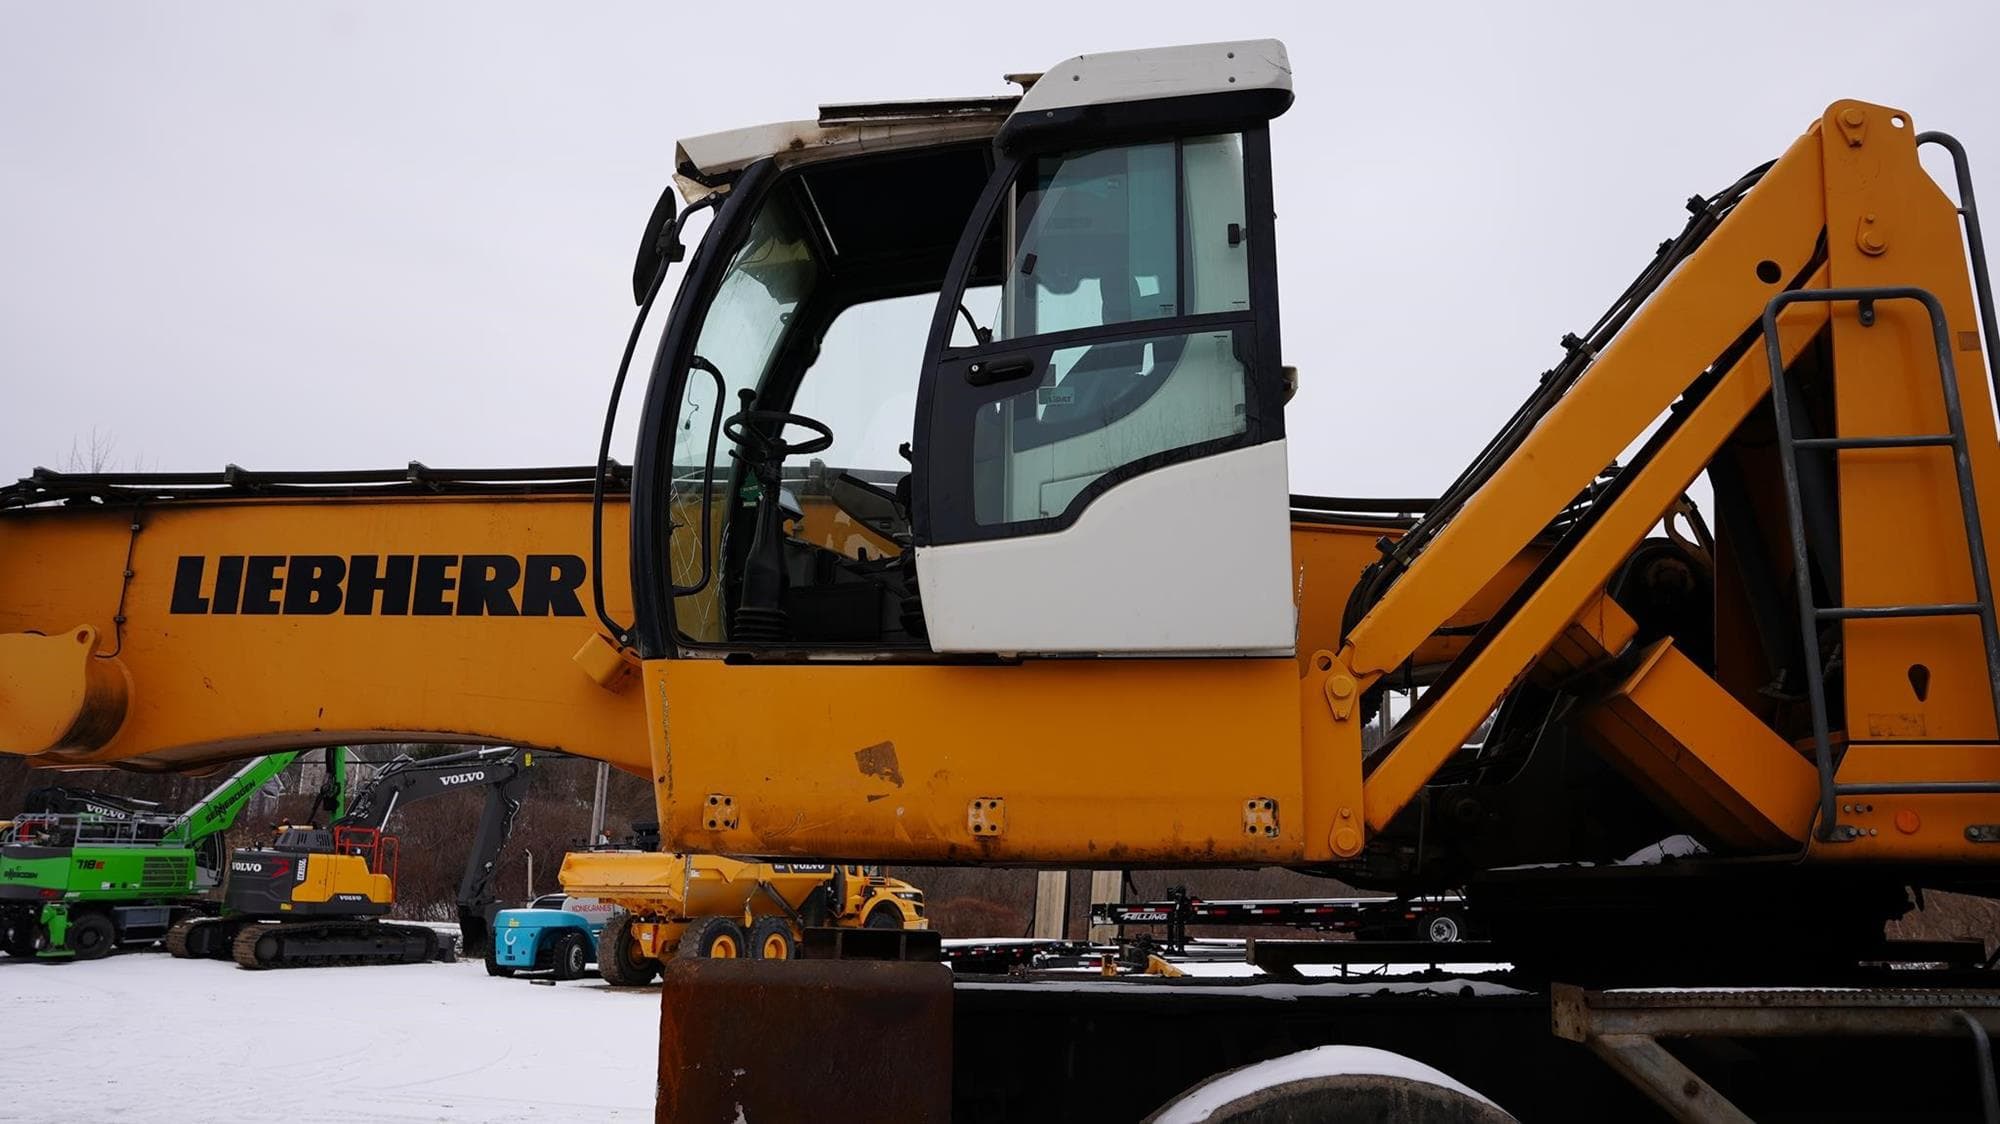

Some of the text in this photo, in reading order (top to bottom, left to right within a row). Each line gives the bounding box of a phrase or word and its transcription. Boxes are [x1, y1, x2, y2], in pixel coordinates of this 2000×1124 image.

[169, 554, 587, 616] LIEBHERR
[440, 771, 485, 786] VOLVO
[86, 804, 126, 820] VOLVO
[231, 862, 262, 872] VOLVO
[1120, 912, 1168, 920] FELLING
